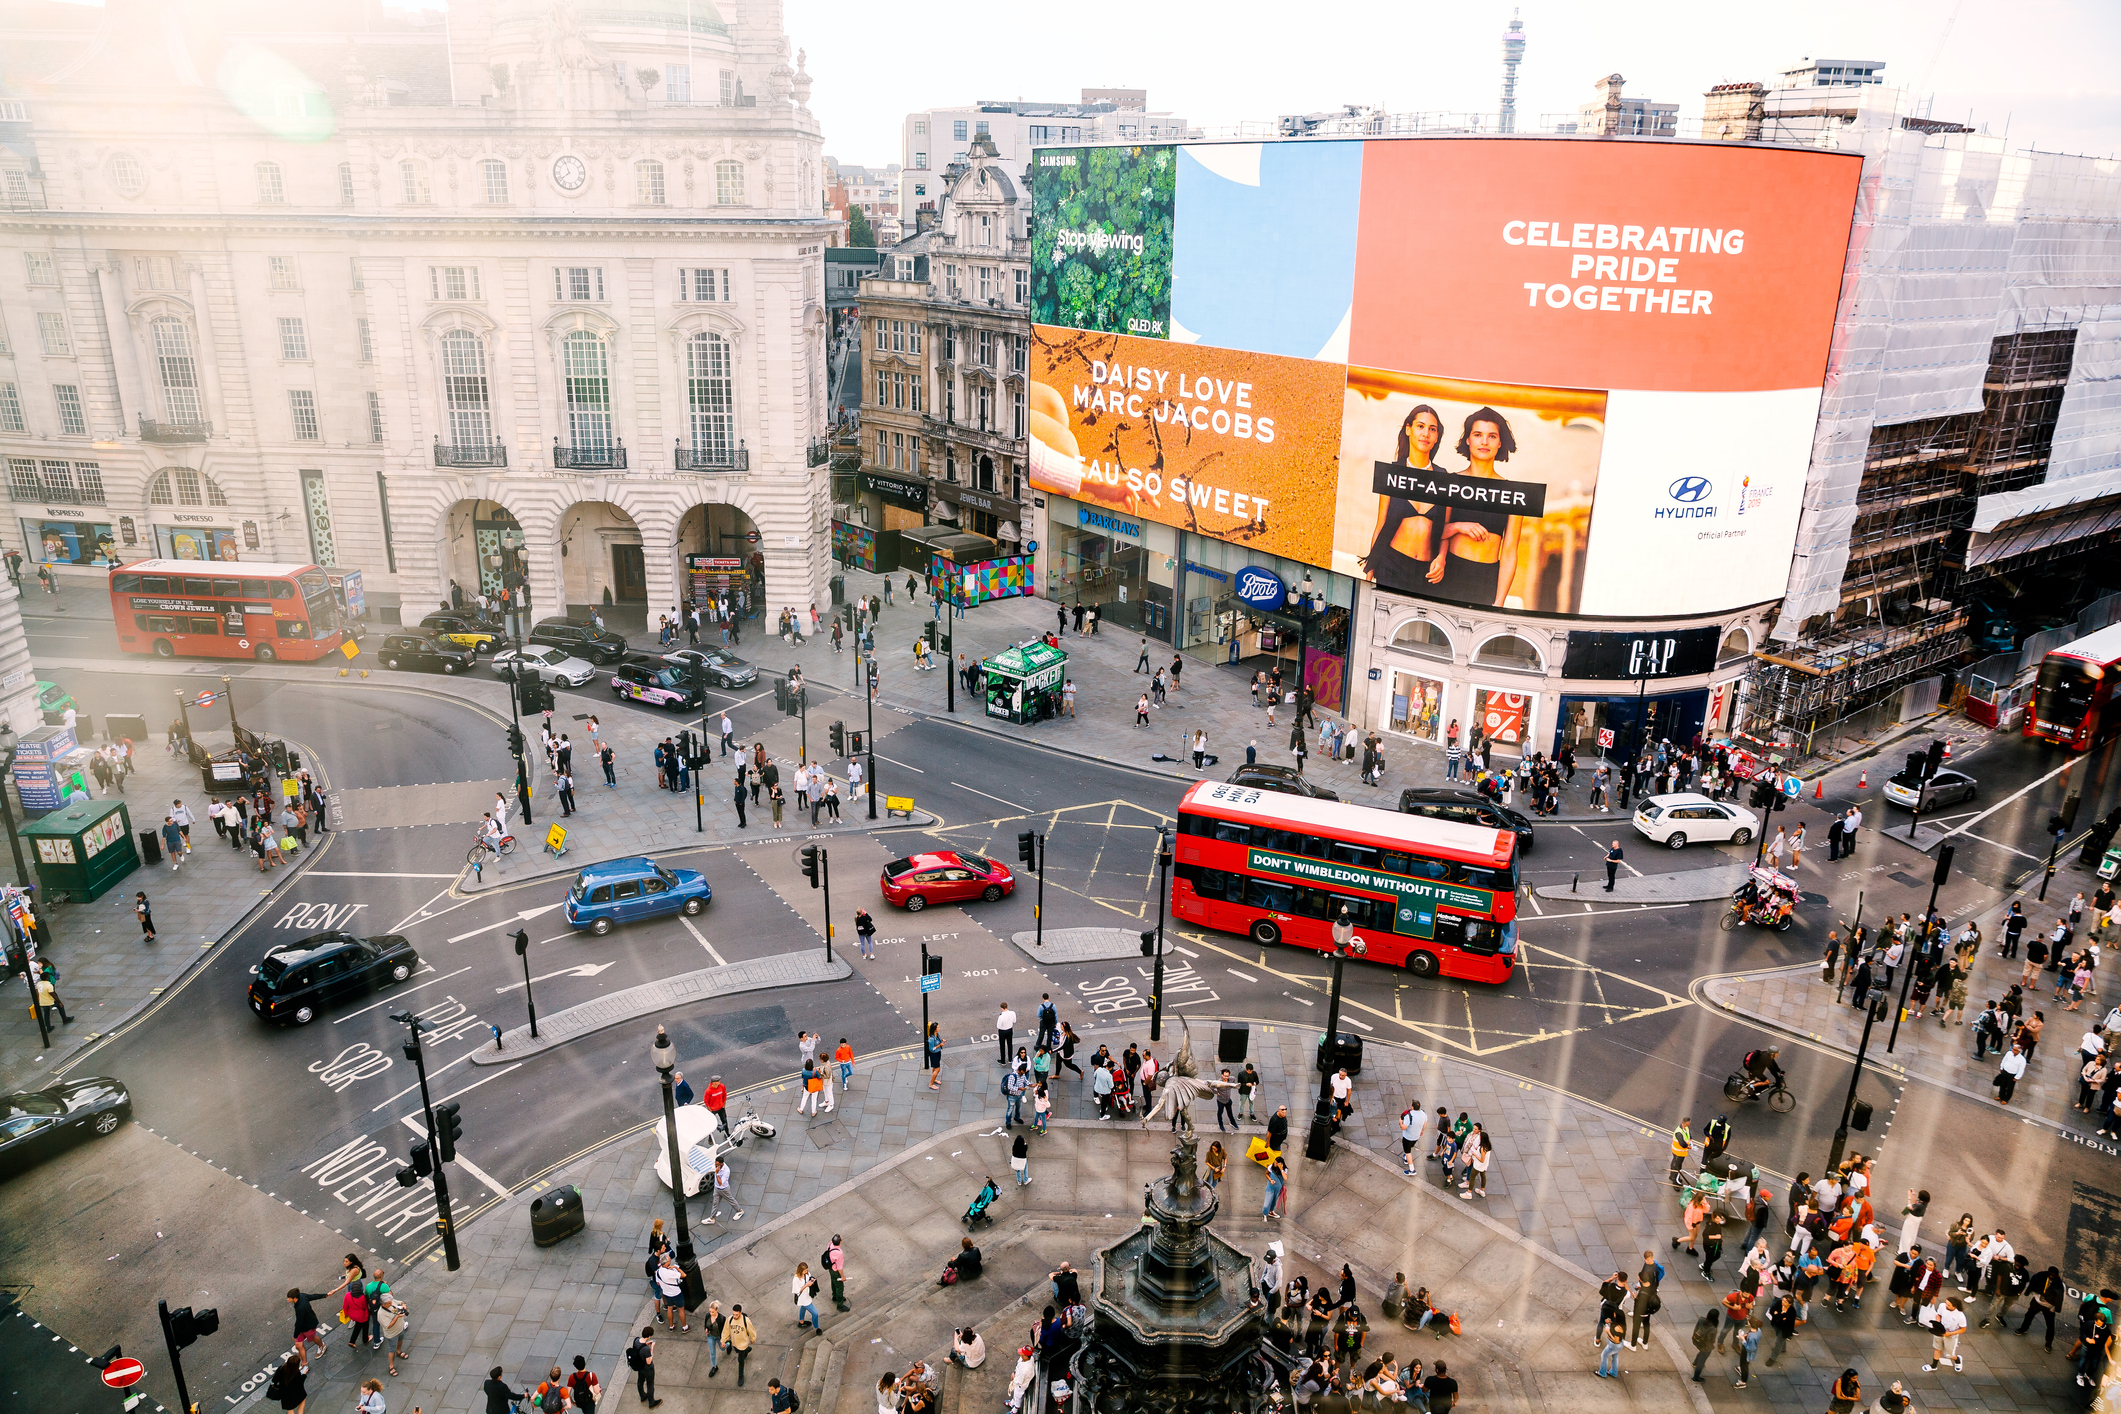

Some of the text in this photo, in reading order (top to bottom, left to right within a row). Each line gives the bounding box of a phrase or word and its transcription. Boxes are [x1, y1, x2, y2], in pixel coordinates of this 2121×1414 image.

[1040, 156, 1076, 166] SAMSUNG
[1058, 229, 1144, 256] Stop viewing
[1502, 220, 1745, 254] CELEBRATING
[1571, 254, 1680, 283] PRIDE
[1524, 282, 1713, 315] TOGETHER
[1128, 318, 1164, 334] QLED 8K
[1092, 360, 1252, 408] DAISY LOVE
[1073, 384, 1275, 443] MARC JACOBS
[877, 480, 903, 490] VITTORIO
[1074, 455, 1269, 522] EAU SO SWEET
[1387, 473, 1526, 506] NET-A-PORTER
[1749, 486, 1773, 498] FRANCE
[46, 508, 84, 517] NESPRESSO
[960, 492, 992, 509] JEWEL BAR
[1654, 506, 1717, 518] HYUNDAI
[1748, 498, 1761, 508] 2019
[174, 513, 213, 522] NESPRESSO
[1090, 512, 1139, 538] BARCLAYS
[1698, 530, 1747, 540] Official Partner
[1185, 562, 1228, 583] pharmacy
[1238, 572, 1278, 601] Boots
[1629, 639, 1676, 674] GAP
[51, 731, 69, 744] THEATRE
[54, 737, 71, 749] TICKETS
[1254, 854, 1448, 899] DON'T WIMBLEDON WITHOUT IT
[273, 902, 368, 930] RGNT
[875, 932, 960, 946] LOOK LEFT
[962, 968, 998, 977] LOOK
[1137, 960, 1220, 1008] LANE
[1078, 976, 1148, 1014] BUS
[971, 1033, 999, 1044] LOO
[308, 1042, 393, 1093] SQR
[2061, 1130, 2117, 1156] RIGHT
[301, 1134, 470, 1244] NO ENTRY
[224, 1363, 278, 1404] LOOK
